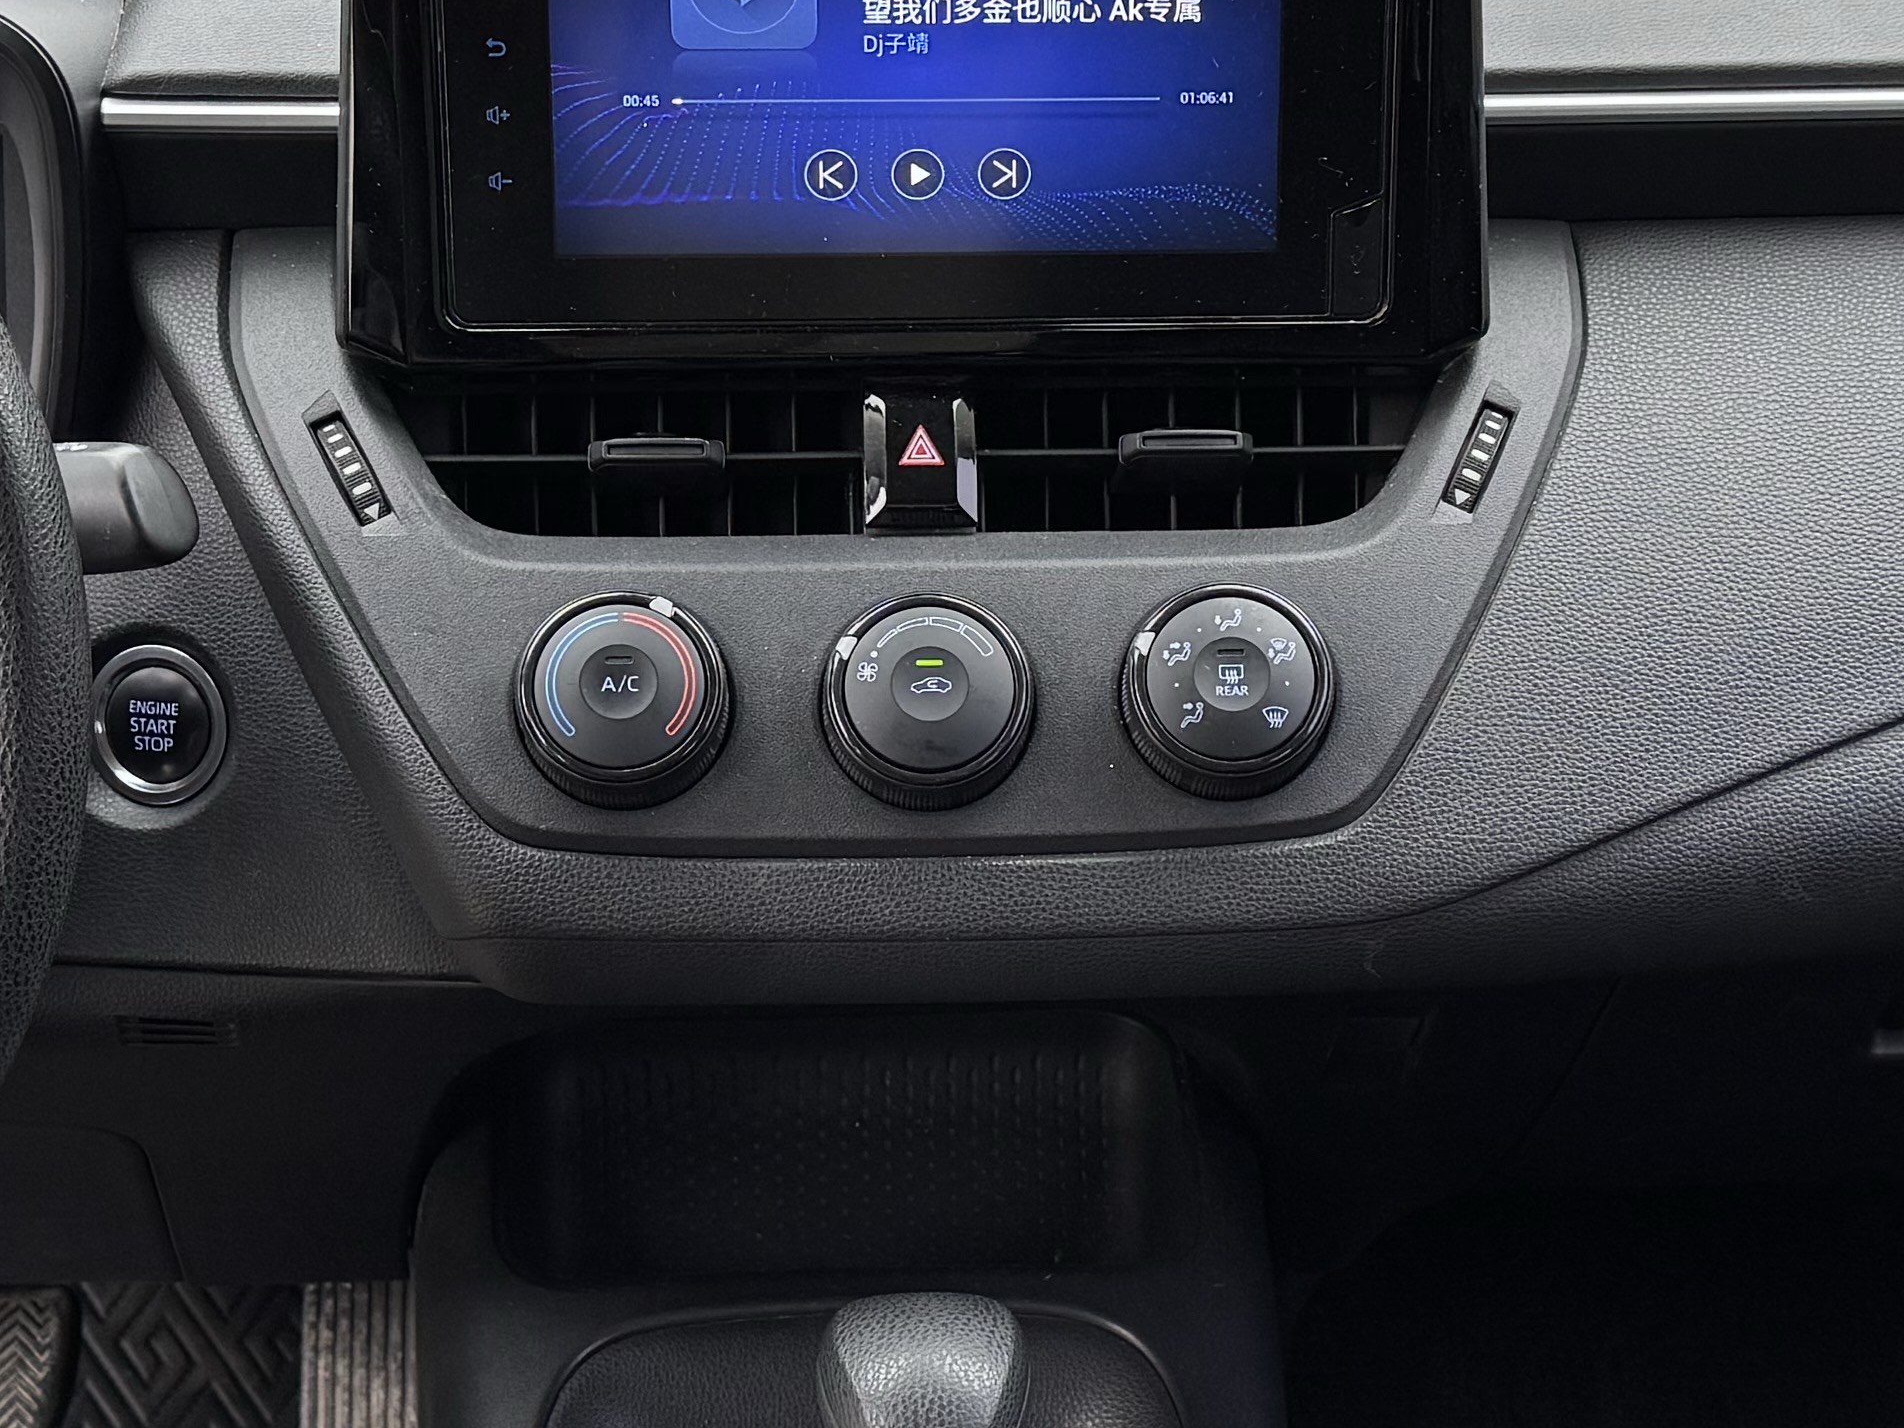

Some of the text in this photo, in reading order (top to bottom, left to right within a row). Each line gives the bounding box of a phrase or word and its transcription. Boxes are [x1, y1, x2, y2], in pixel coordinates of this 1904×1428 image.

[622, 94, 660, 107] 00:45
[1179, 91, 1234, 105] 01:06:41
[600, 674, 640, 693] A/C
[1215, 685, 1249, 697] REAR
[129, 699, 179, 716] ENGINE
[130, 717, 177, 735] START
[134, 735, 174, 752] STOP
